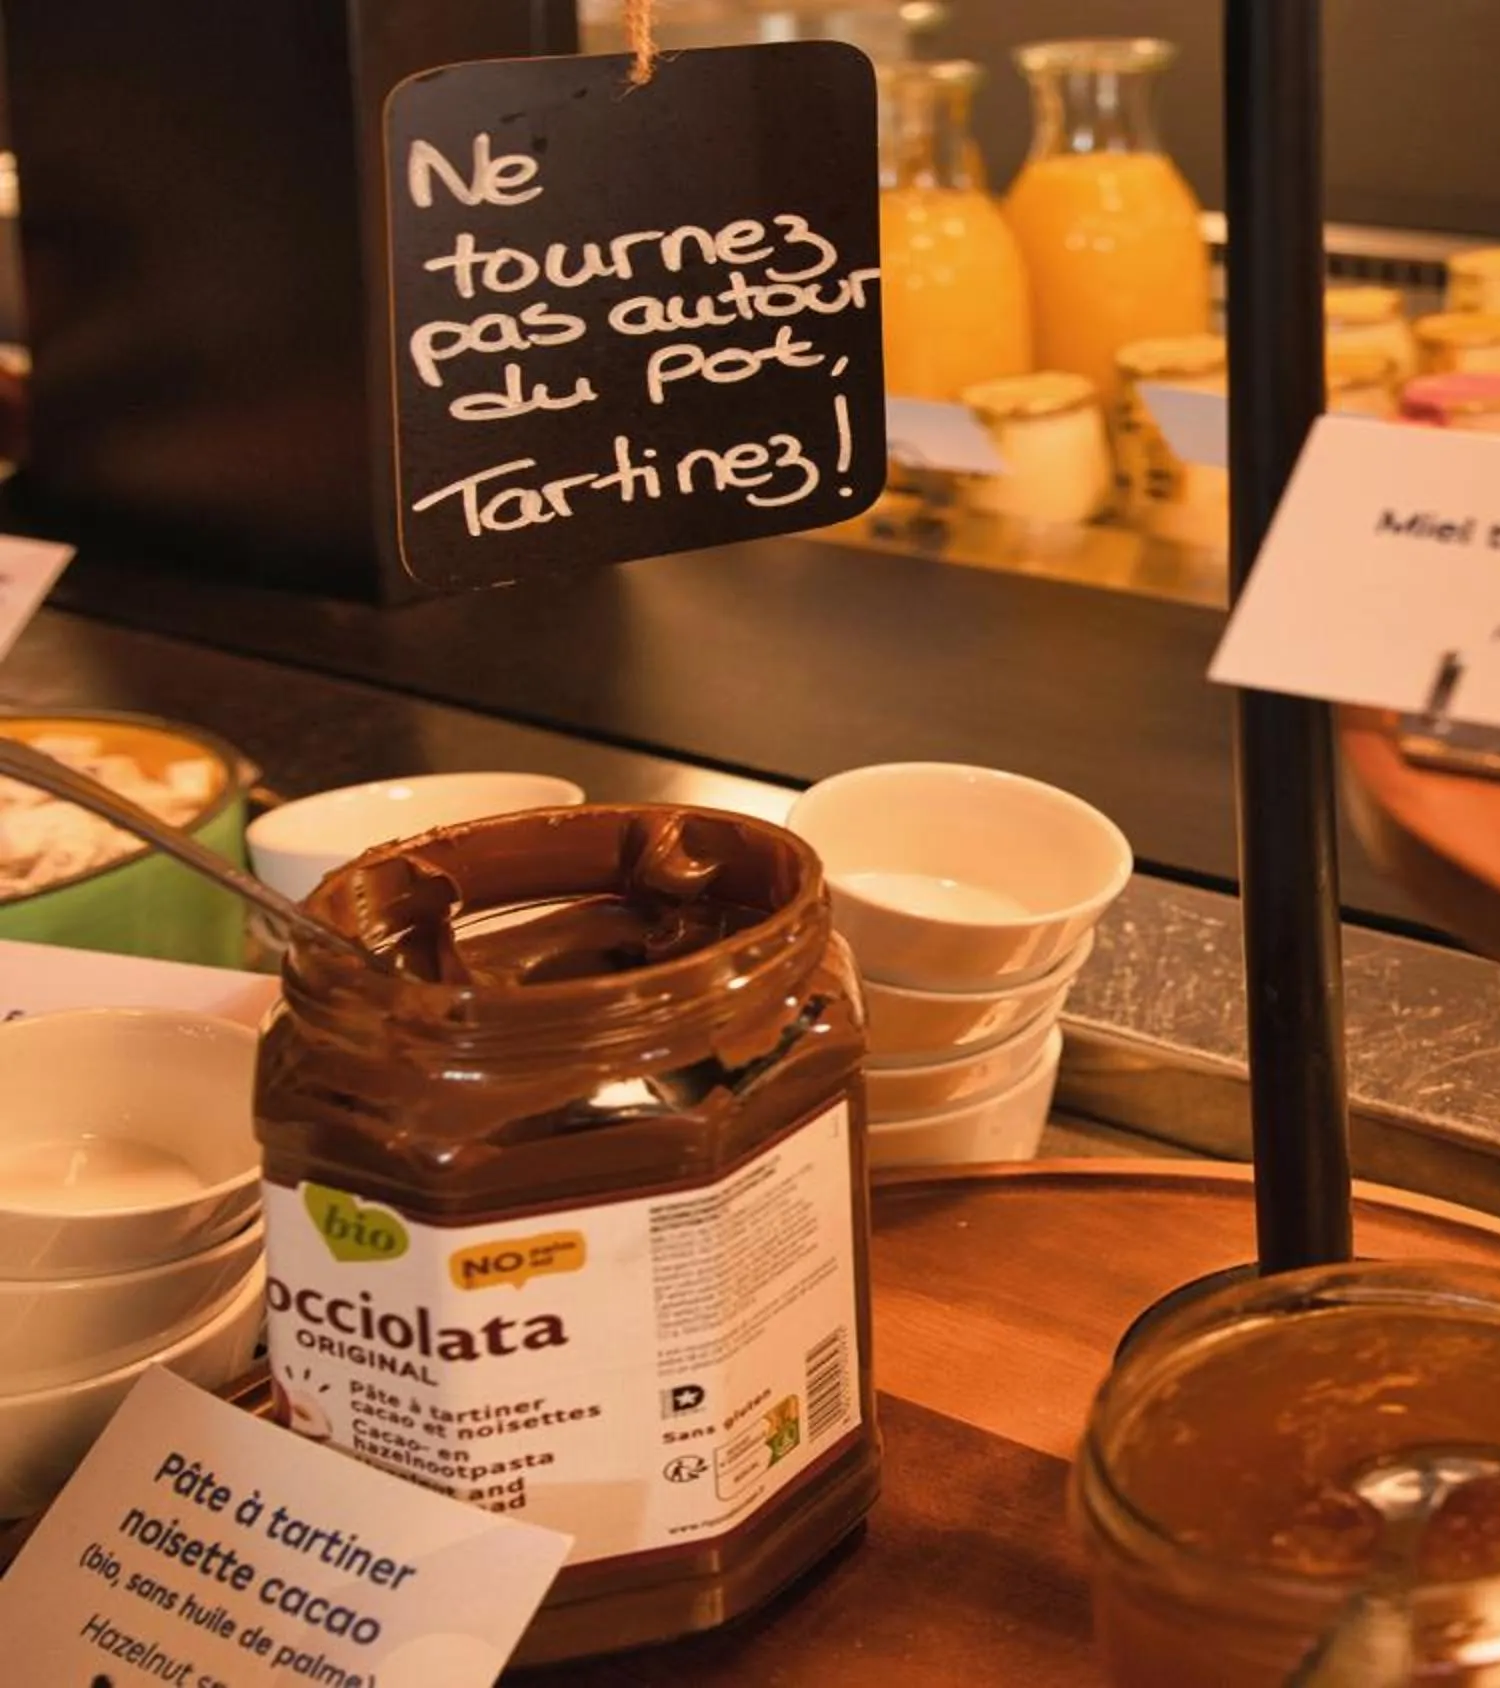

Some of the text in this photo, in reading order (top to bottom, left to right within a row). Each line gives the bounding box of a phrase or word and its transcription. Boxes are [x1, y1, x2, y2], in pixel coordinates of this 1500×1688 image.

[408, 132, 543, 207] Ne
[424, 213, 838, 299] tournez
[409, 267, 882, 388] pas autour
[448, 362, 598, 421] du
[1374, 508, 1477, 546] Miel
[324, 1203, 395, 1254] bio
[461, 1251, 524, 1279] NO
[295, 1328, 440, 1387] ORIGINAL
[349, 1379, 546, 1423] Pâte à tartiner
[350, 1400, 602, 1441] cacao et noisettes
[351, 1418, 471, 1463] Cacao- en
[352, 1434, 556, 1481] hazelnootpasta
[662, 1425, 717, 1445] Sans
[467, 1477, 526, 1502] and
[153, 1452, 418, 1592] Pâte à tartiner
[79, 1542, 123, 1588] (bio,
[124, 1572, 180, 1612] sans
[177, 1593, 239, 1640] huile
[238, 1626, 274, 1657] de
[118, 1506, 382, 1647] noisette cacao
[79, 1613, 196, 1688] Hazelnut
